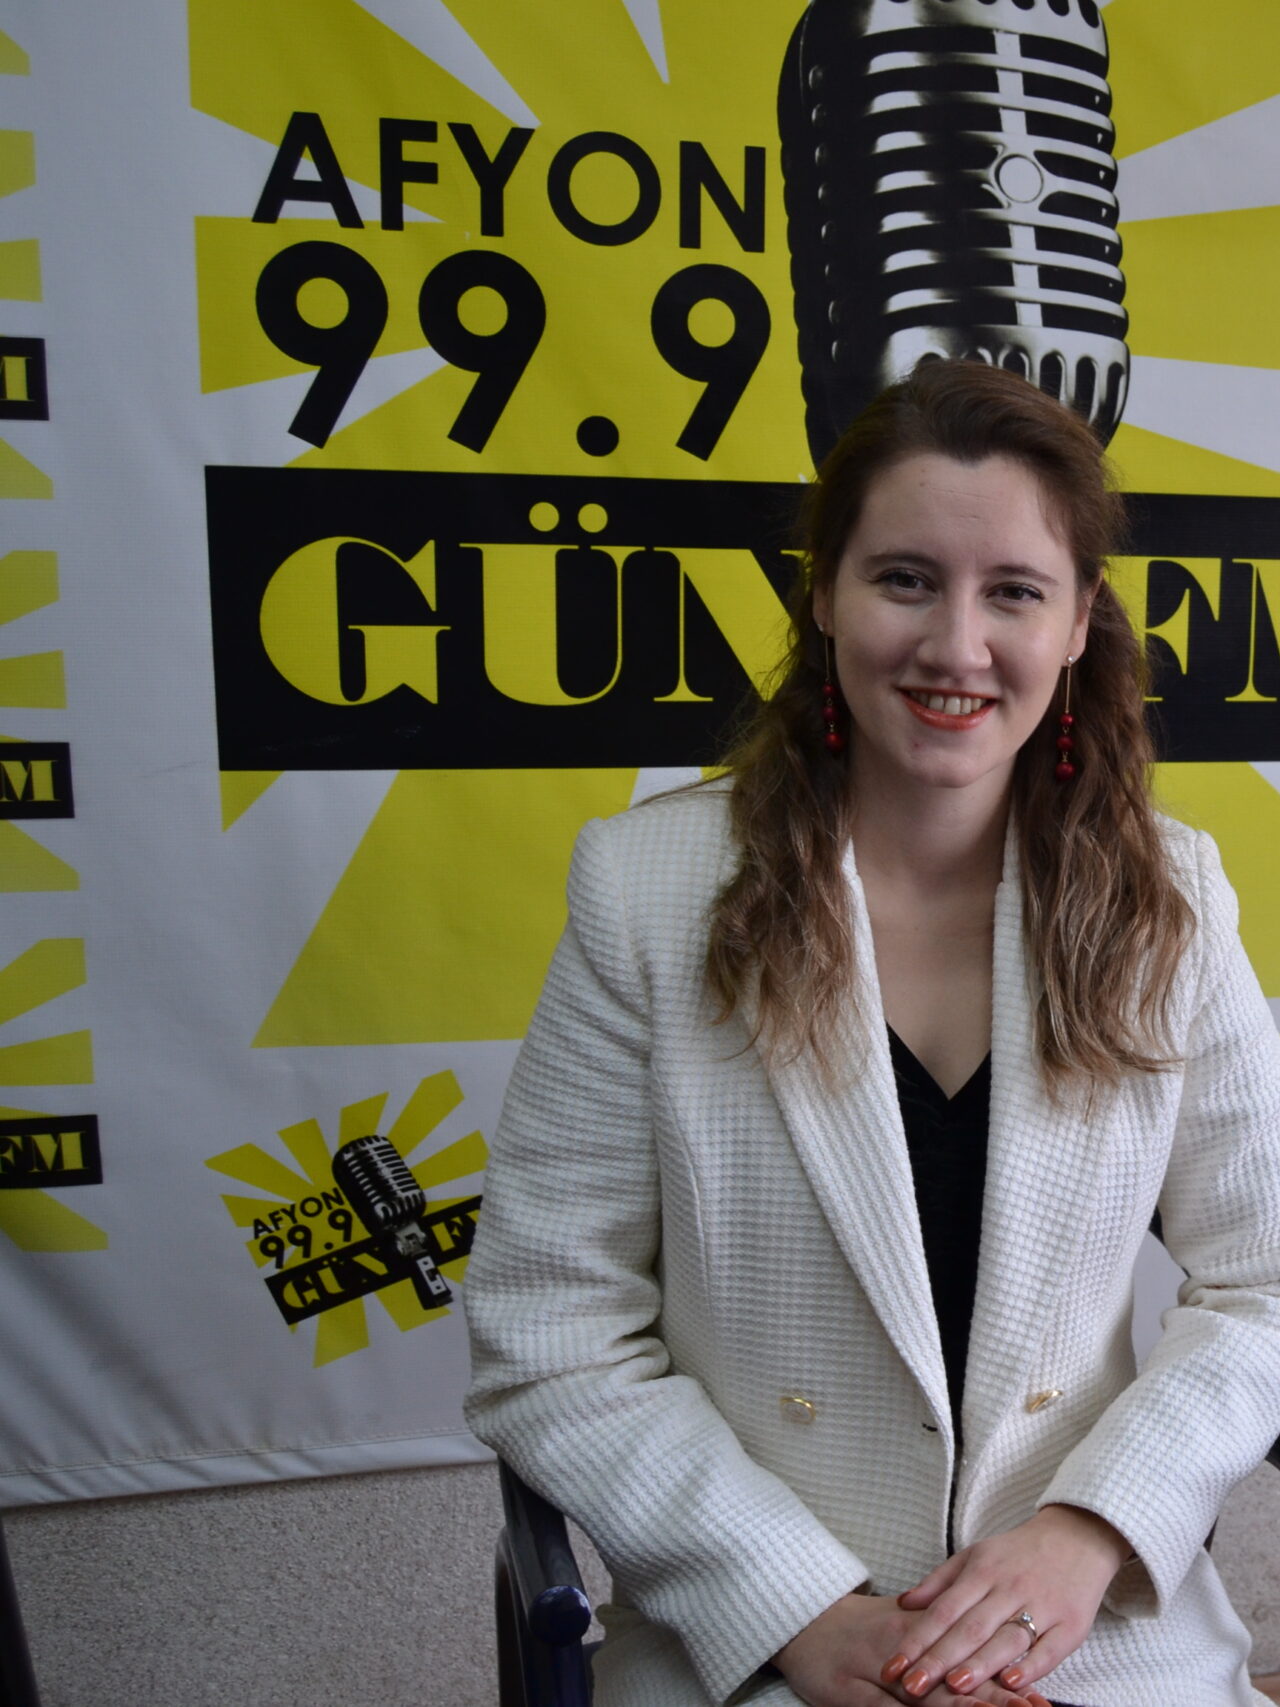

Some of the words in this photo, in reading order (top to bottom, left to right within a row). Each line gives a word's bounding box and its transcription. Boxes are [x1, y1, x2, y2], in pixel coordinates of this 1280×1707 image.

[251, 111, 766, 253] AFYON
[255, 241, 771, 461] 99.9
[253, 1187, 346, 1239] AFYON
[259, 1208, 353, 1270] 99.9
